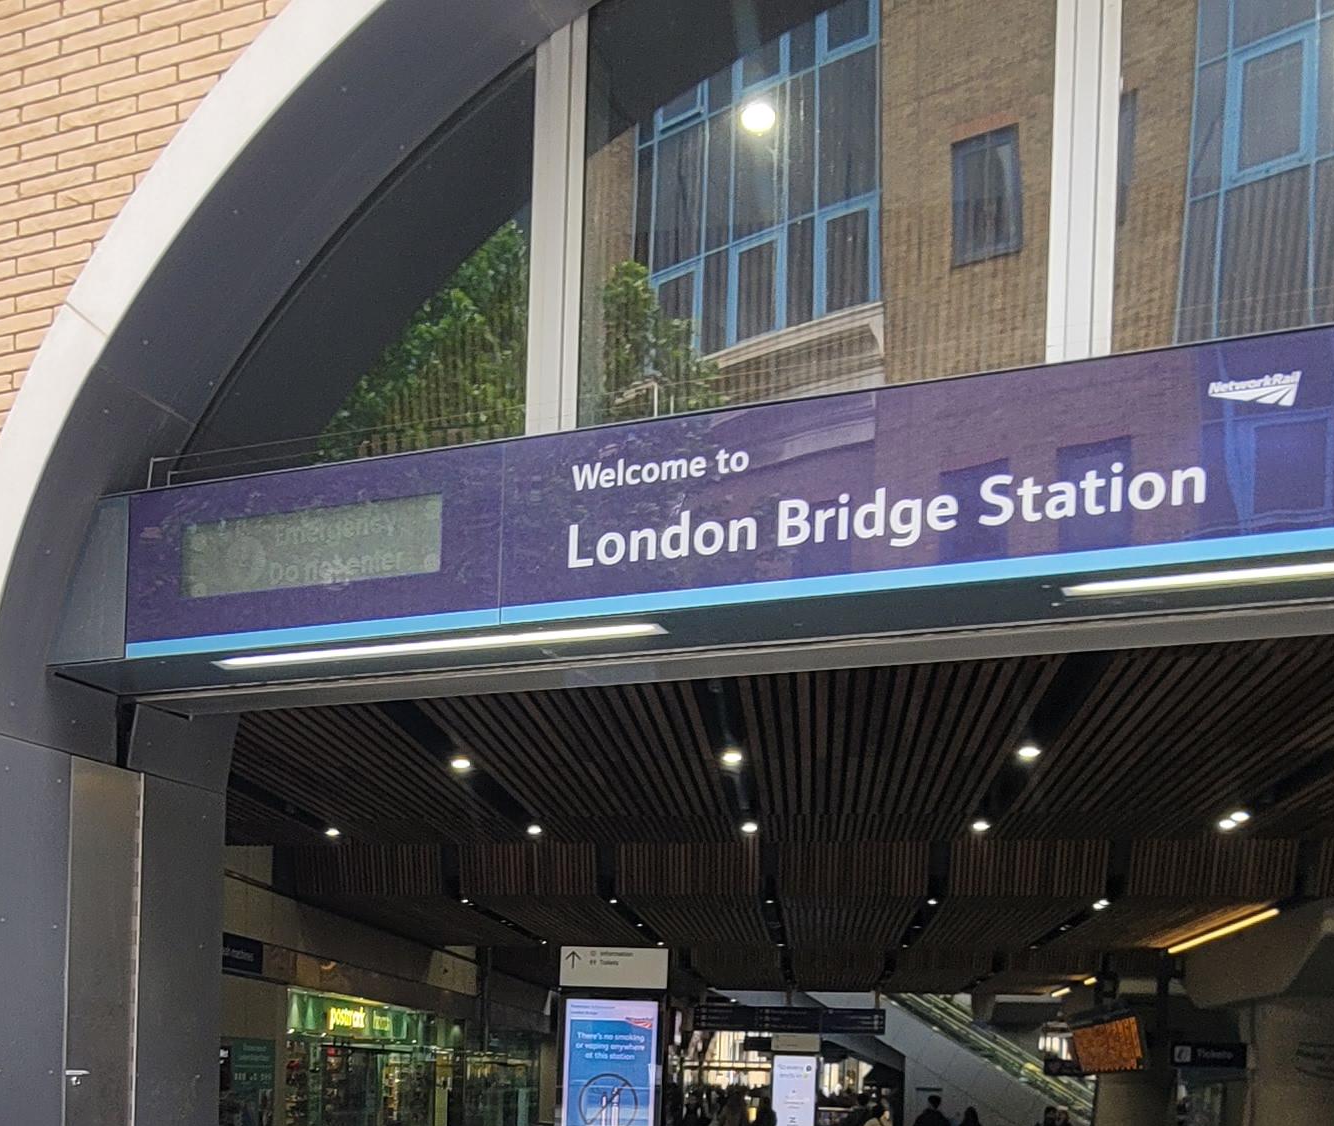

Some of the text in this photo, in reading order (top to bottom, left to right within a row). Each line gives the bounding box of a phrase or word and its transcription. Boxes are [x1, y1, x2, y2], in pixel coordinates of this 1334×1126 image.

[571, 447, 750, 491] Welcome to
[567, 462, 1207, 569] London Bridge Station
[615, 1033, 645, 1043] smoking
[609, 1052, 635, 1060] station
